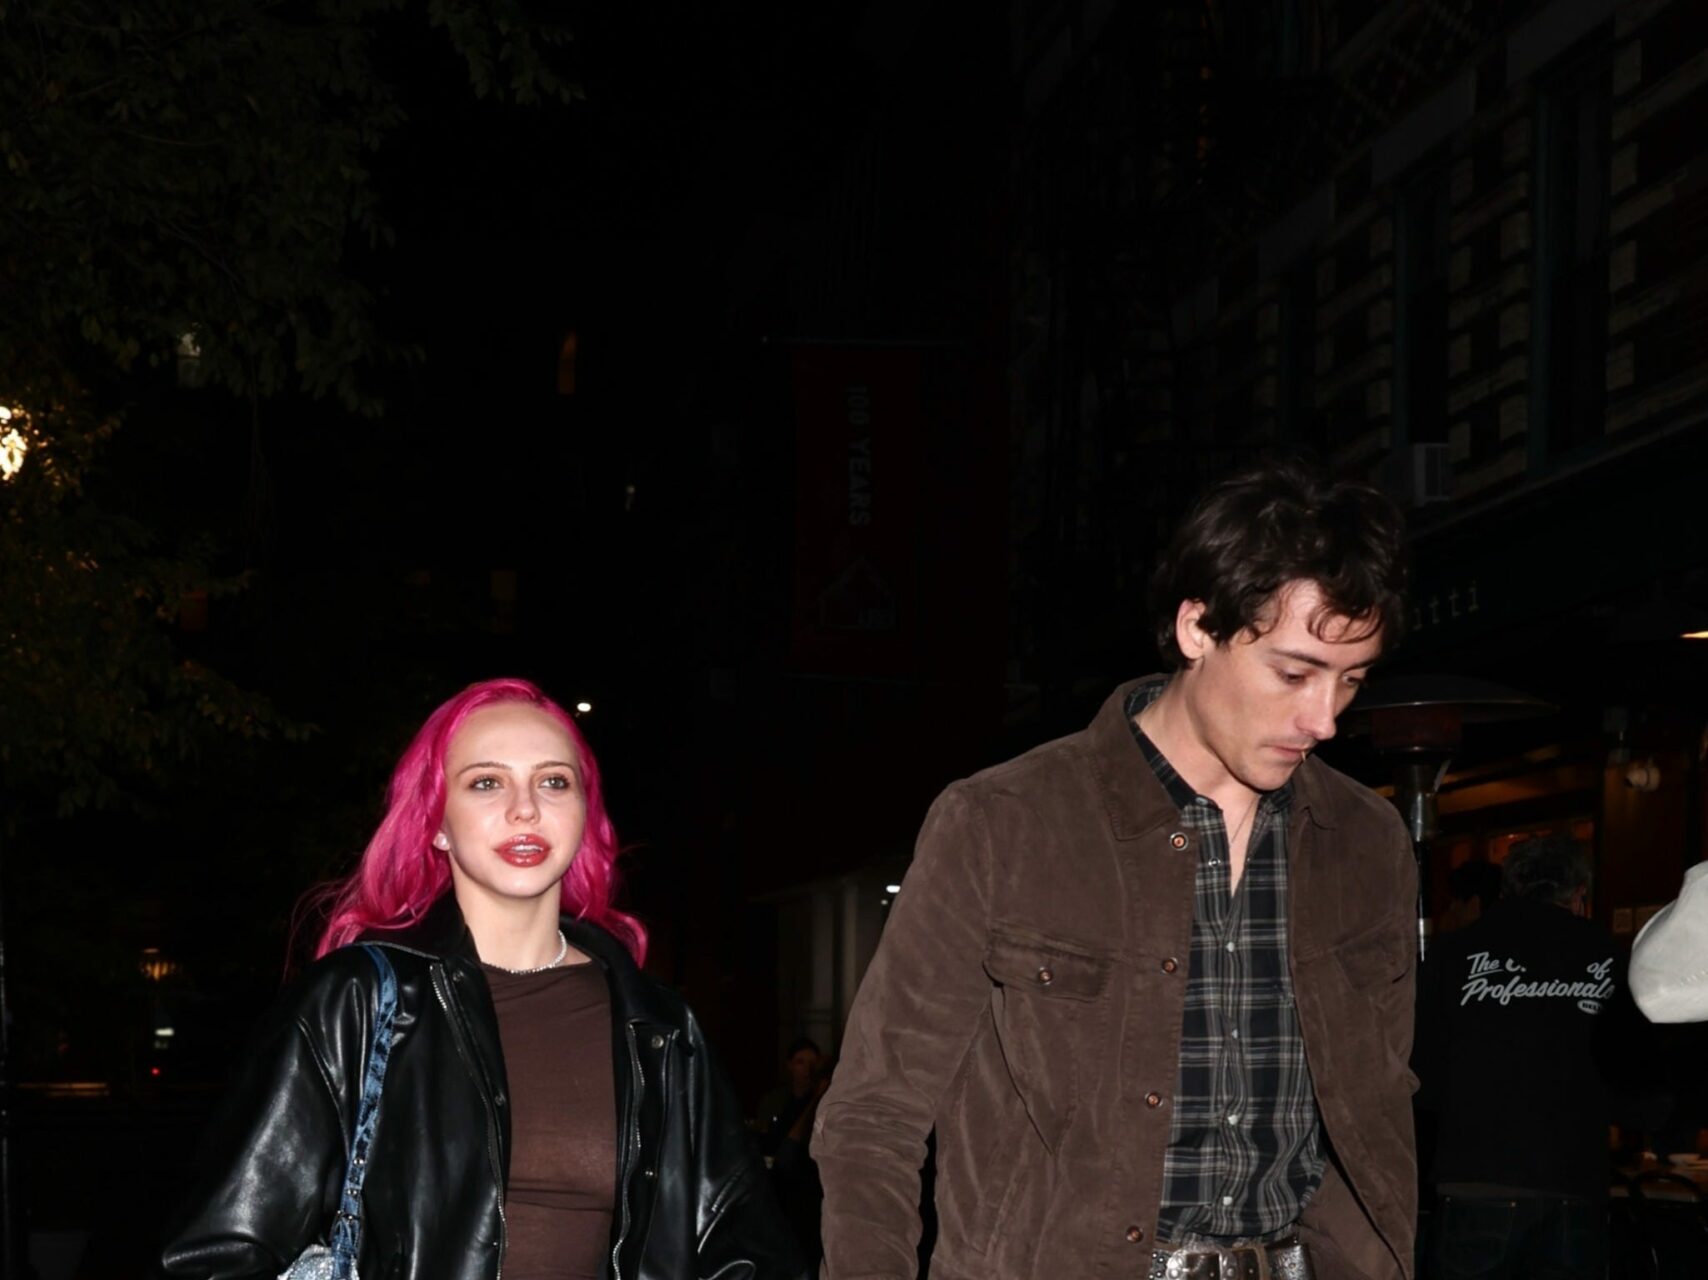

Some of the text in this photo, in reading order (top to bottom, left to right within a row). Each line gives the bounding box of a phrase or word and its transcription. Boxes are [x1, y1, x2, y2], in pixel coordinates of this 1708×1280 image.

[844, 384, 872, 528] 100 YEARS
[1467, 952, 1501, 976] The
[1586, 957, 1613, 980] of
